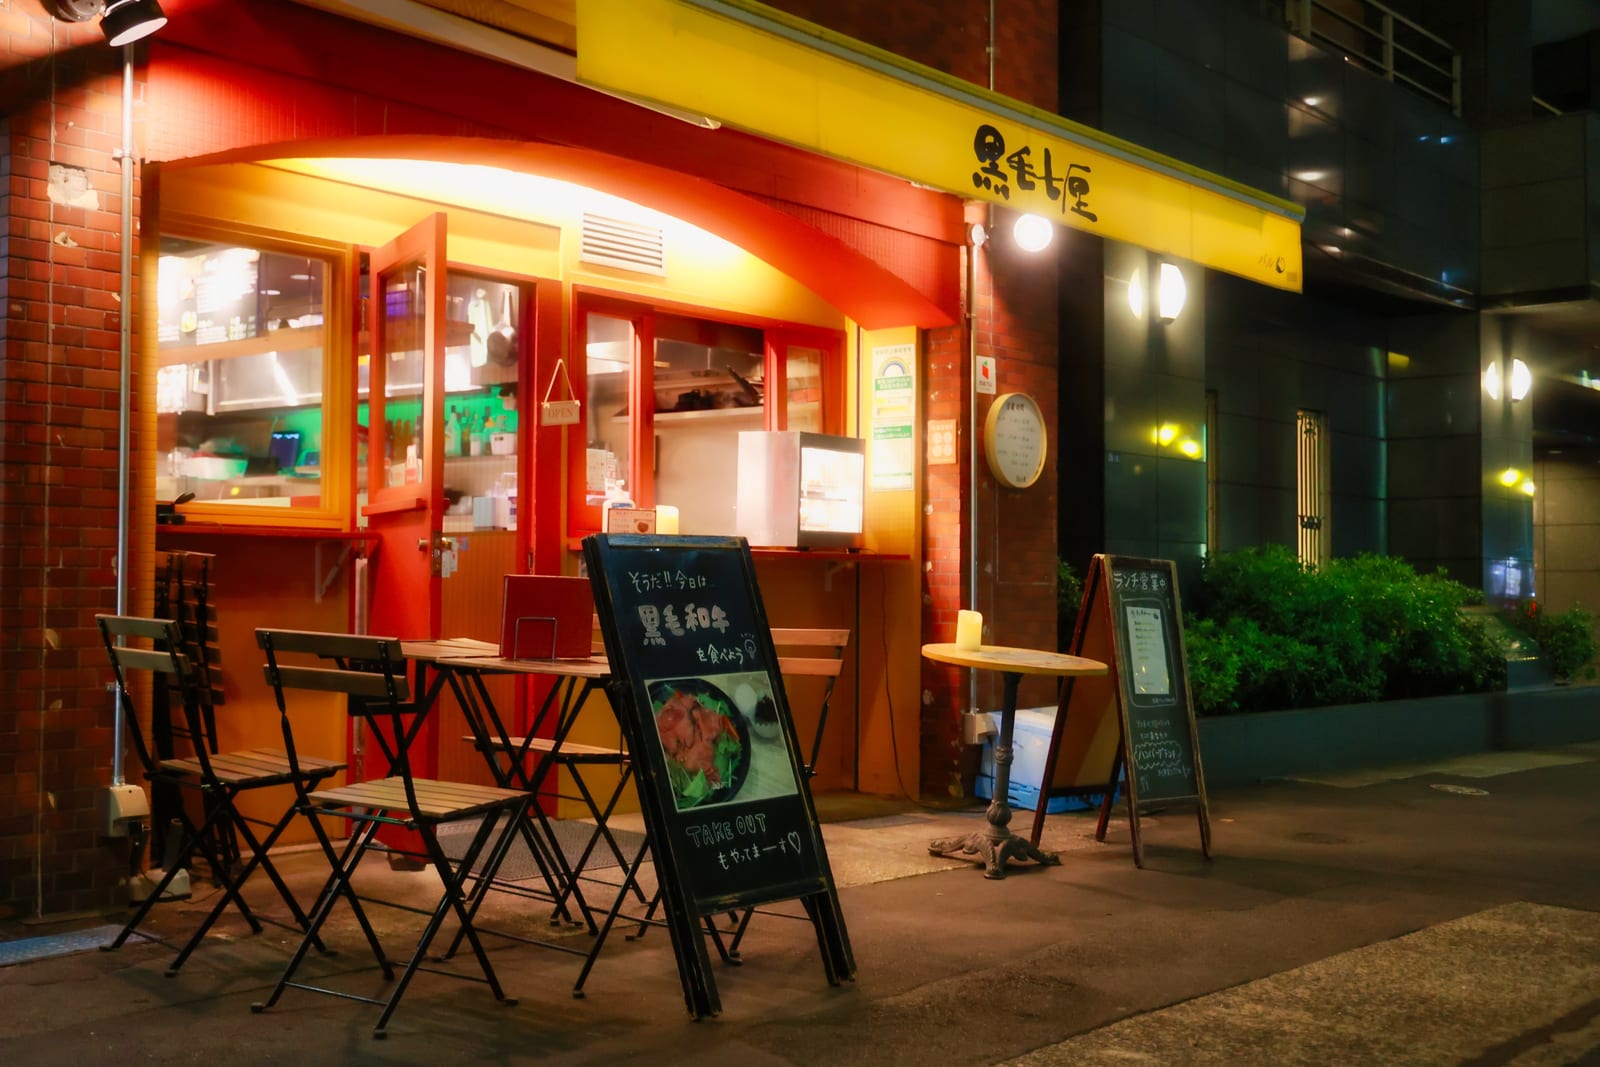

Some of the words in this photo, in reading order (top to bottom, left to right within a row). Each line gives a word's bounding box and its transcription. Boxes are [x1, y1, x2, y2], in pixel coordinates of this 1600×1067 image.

[637, 602, 730, 646] 黒毛和牛
[696, 643, 744, 665] を食べよう
[686, 821, 734, 848] TAKE
[736, 813, 766, 835] OUT
